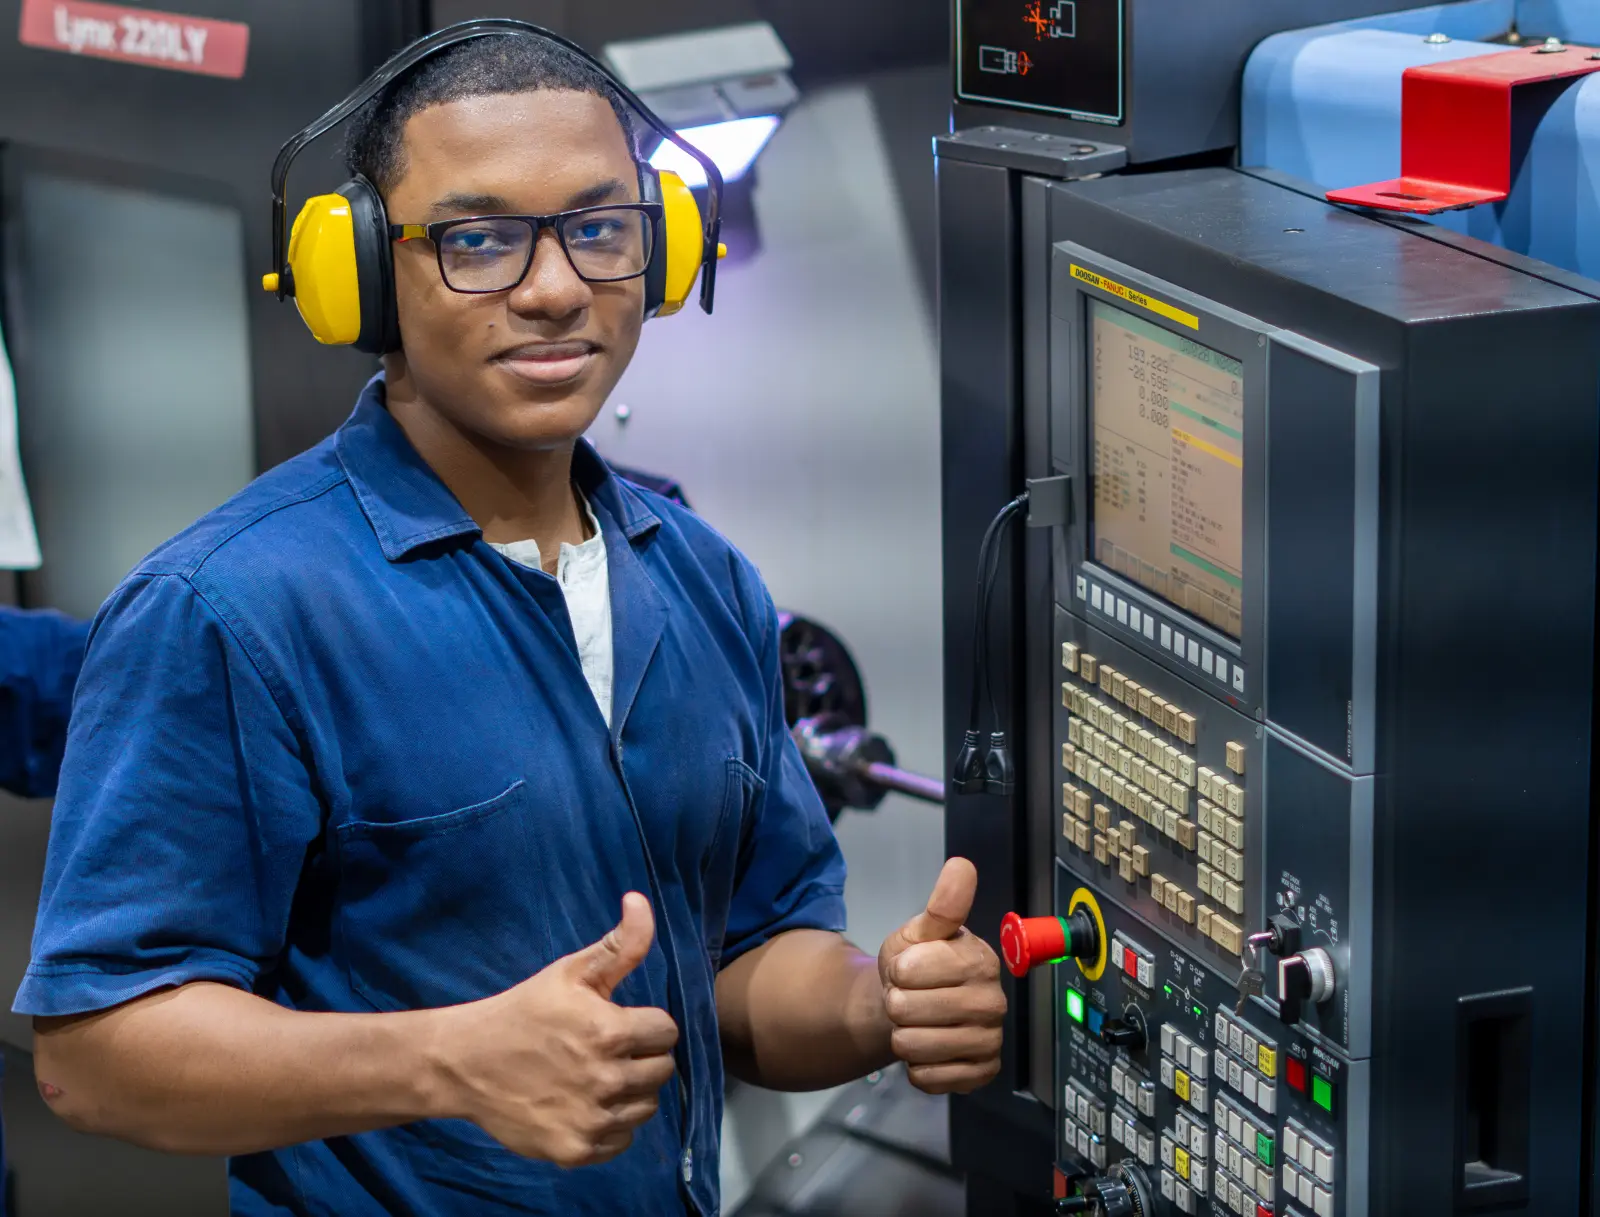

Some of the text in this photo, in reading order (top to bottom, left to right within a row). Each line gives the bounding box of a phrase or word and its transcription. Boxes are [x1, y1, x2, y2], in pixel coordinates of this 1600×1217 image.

[54, 4, 208, 65] Lynx 220LY
[1075, 268, 1099, 285] DOOSAN
[1103, 279, 1124, 296] FANUC
[1128, 291, 1148, 306] Series
[1139, 385, 1168, 411] 0.000
[1139, 403, 1169, 429] 0.000
[1313, 1046, 1340, 1070] DOOSAN
